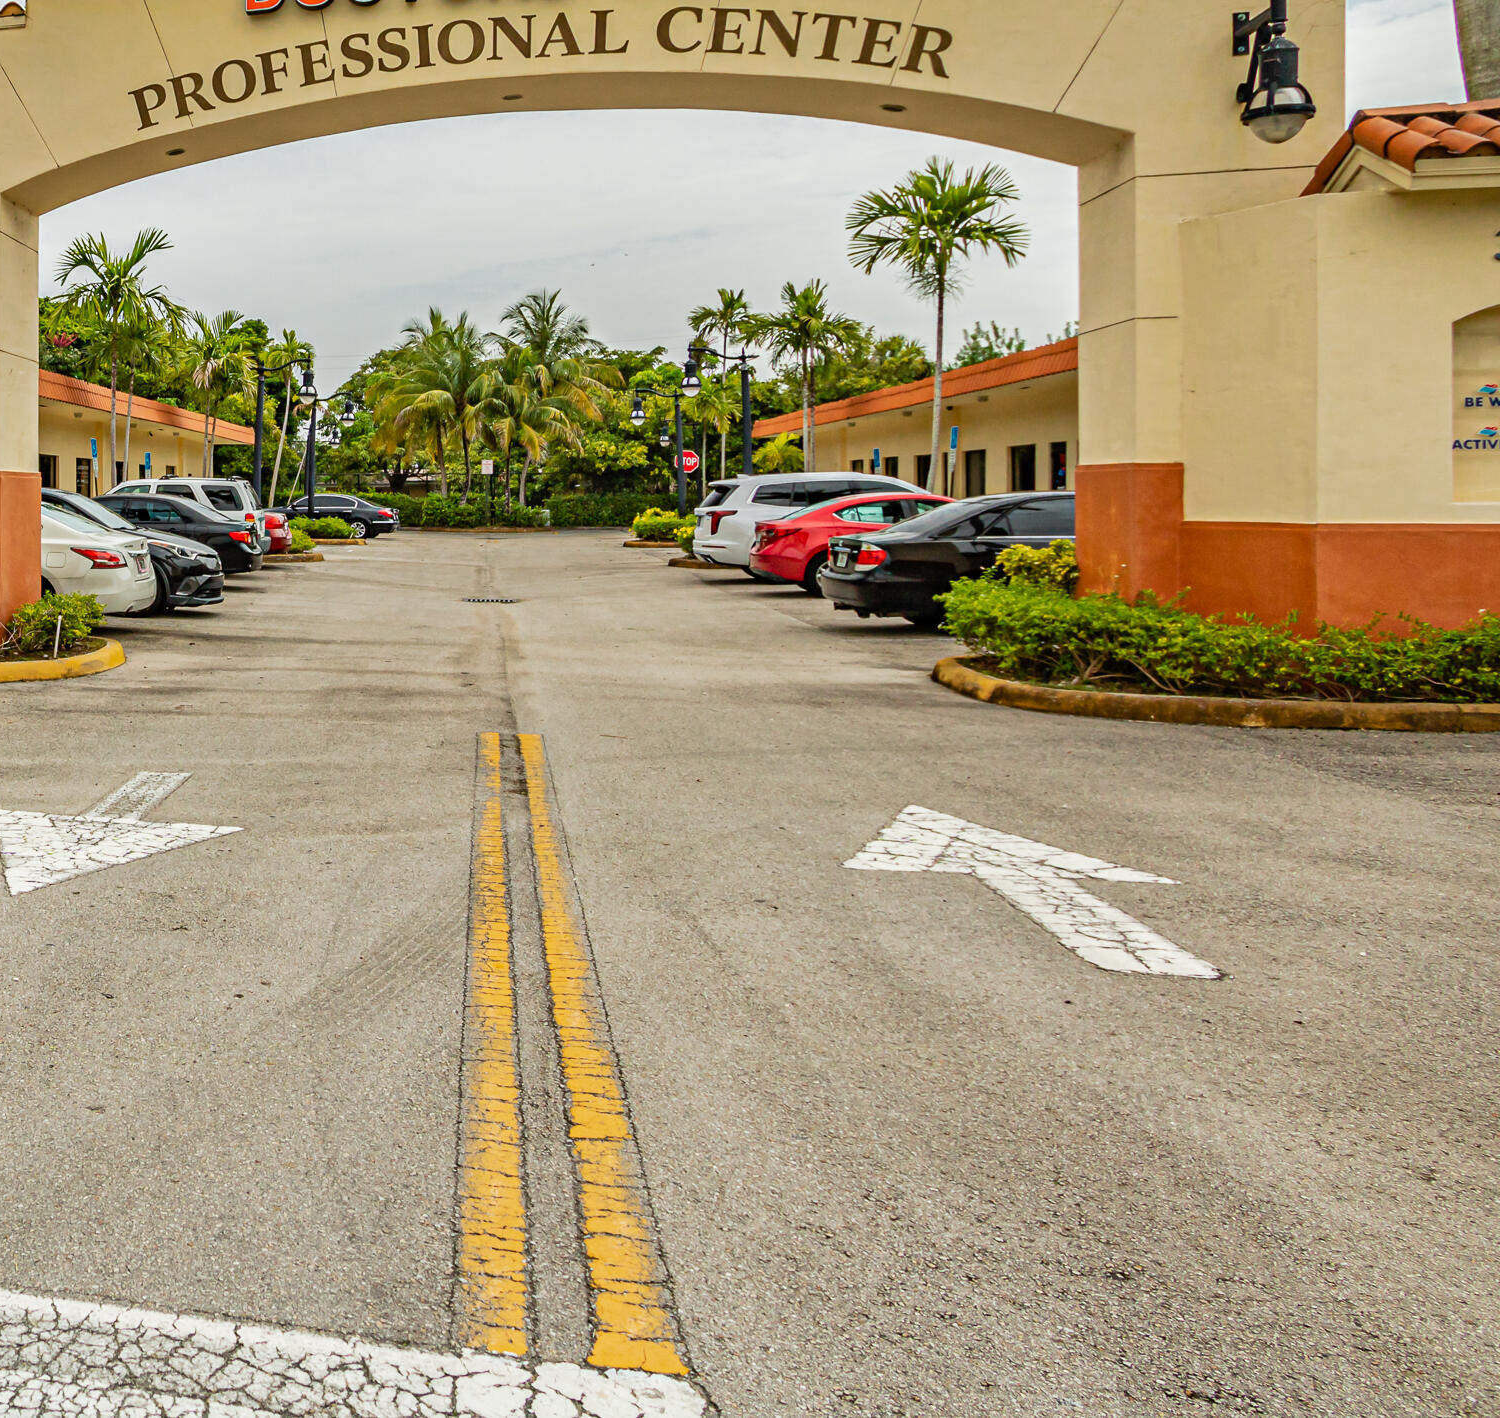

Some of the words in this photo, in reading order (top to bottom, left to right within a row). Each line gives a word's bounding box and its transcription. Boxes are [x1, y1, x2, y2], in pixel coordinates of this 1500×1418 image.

[128, 9, 629, 131] PROFESSIONAL
[656, 7, 953, 79] CENTER
[1465, 397, 1483, 407] BE
[1452, 439, 1500, 449] ACTIV
[681, 457, 698, 466] TOP
